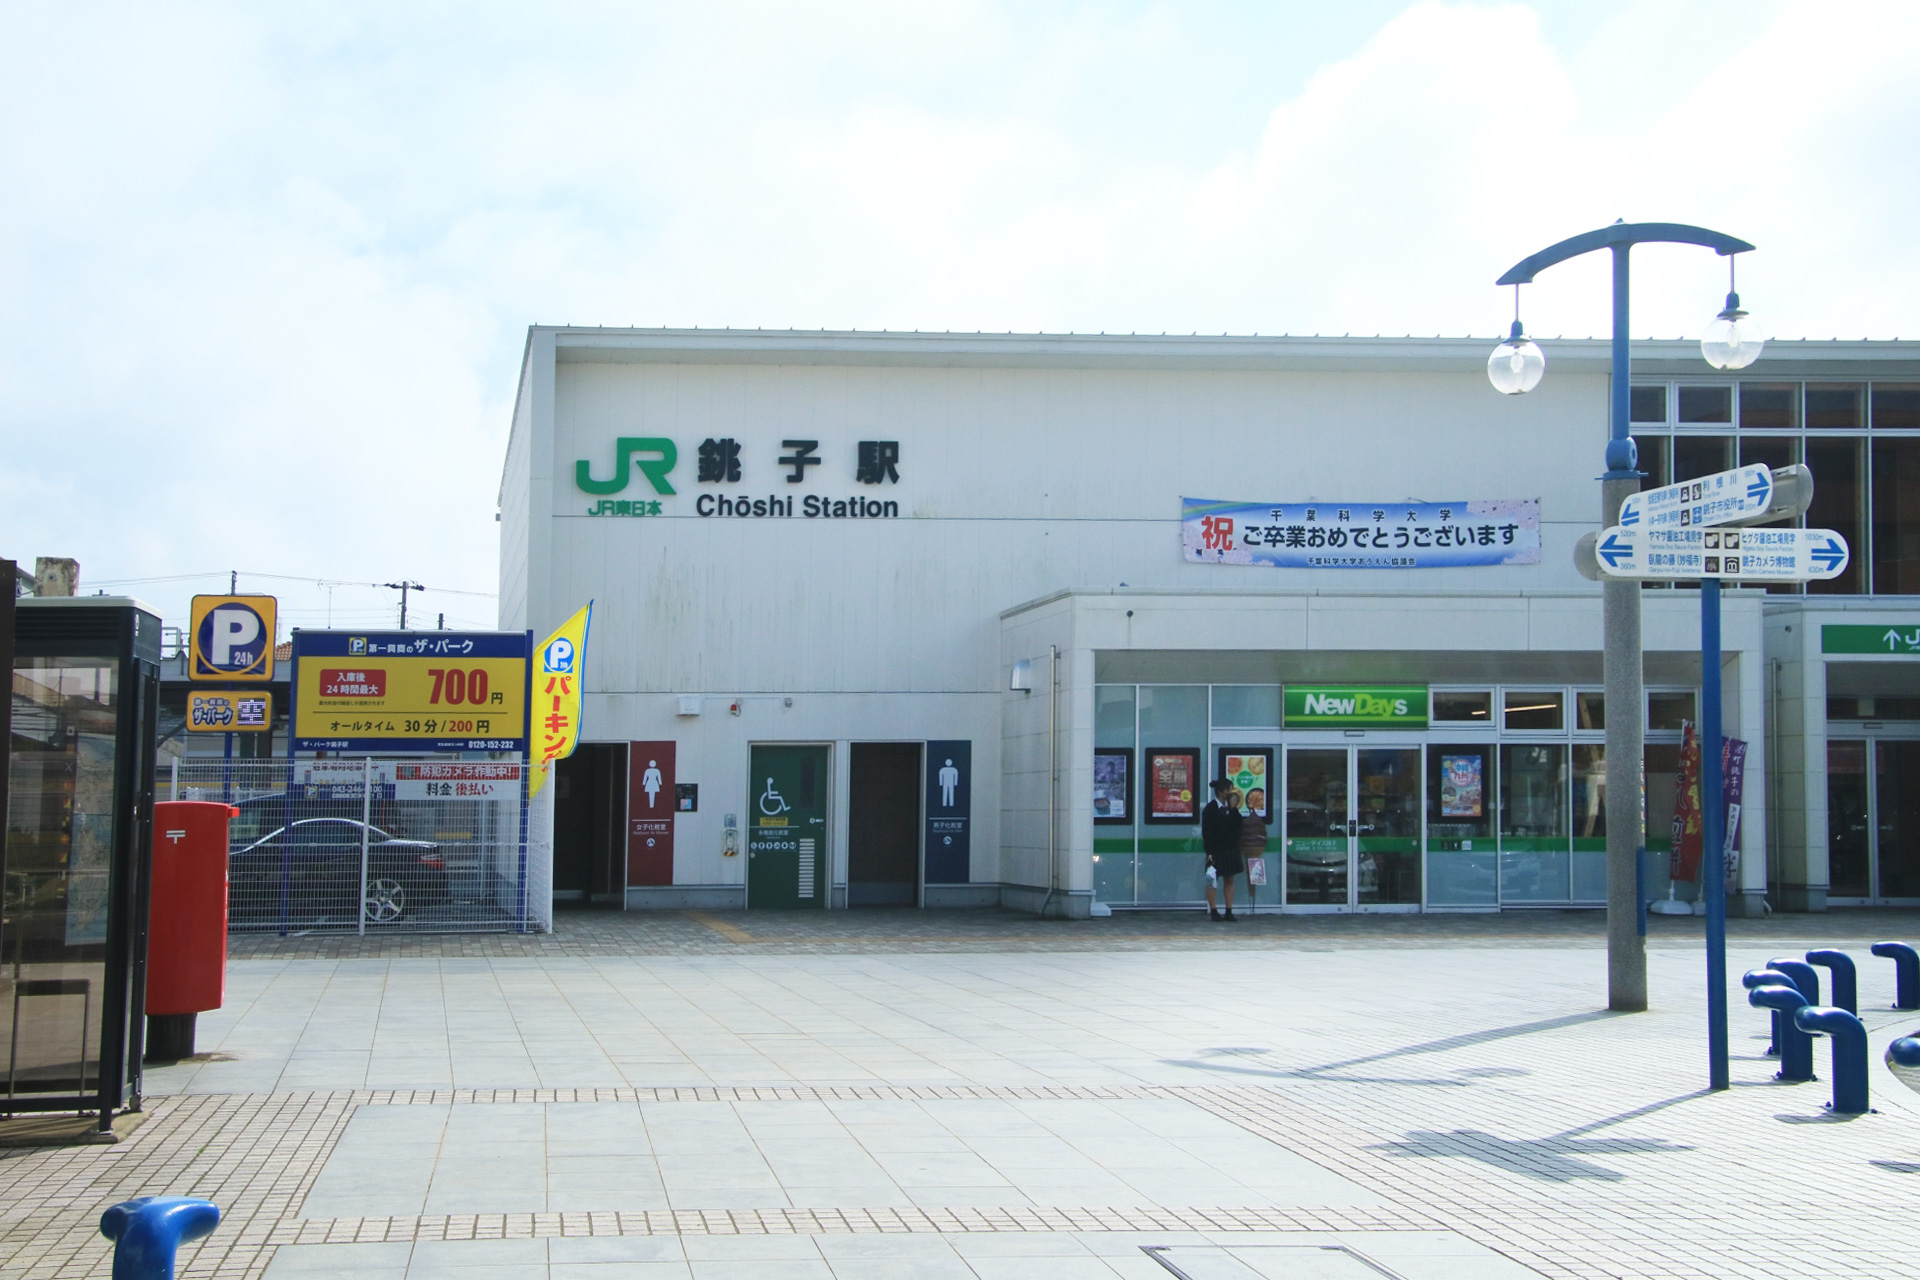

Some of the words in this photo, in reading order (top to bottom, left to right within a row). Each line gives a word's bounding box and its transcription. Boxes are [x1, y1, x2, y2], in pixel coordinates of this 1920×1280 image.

[576, 437, 677, 495] JR
[698, 438, 900, 485] 銚子駅
[588, 500, 662, 516] JR東日本
[696, 494, 792, 517] Chōshi
[803, 495, 898, 517] Station
[1271, 509, 1452, 522] 千葉科学大学
[1201, 516, 1234, 551] 祝
[1243, 524, 1519, 548] ご卒業おめでとうございます
[212, 609, 260, 665] P
[234, 652, 254, 665] 24h
[337, 672, 366, 683] 入庫後
[428, 669, 488, 705] 700
[491, 692, 503, 705] 円
[237, 699, 266, 725] 空
[1303, 693, 1408, 718] NewDays
[330, 720, 395, 732] オールタイム
[468, 740, 514, 749] 0120-152-232
